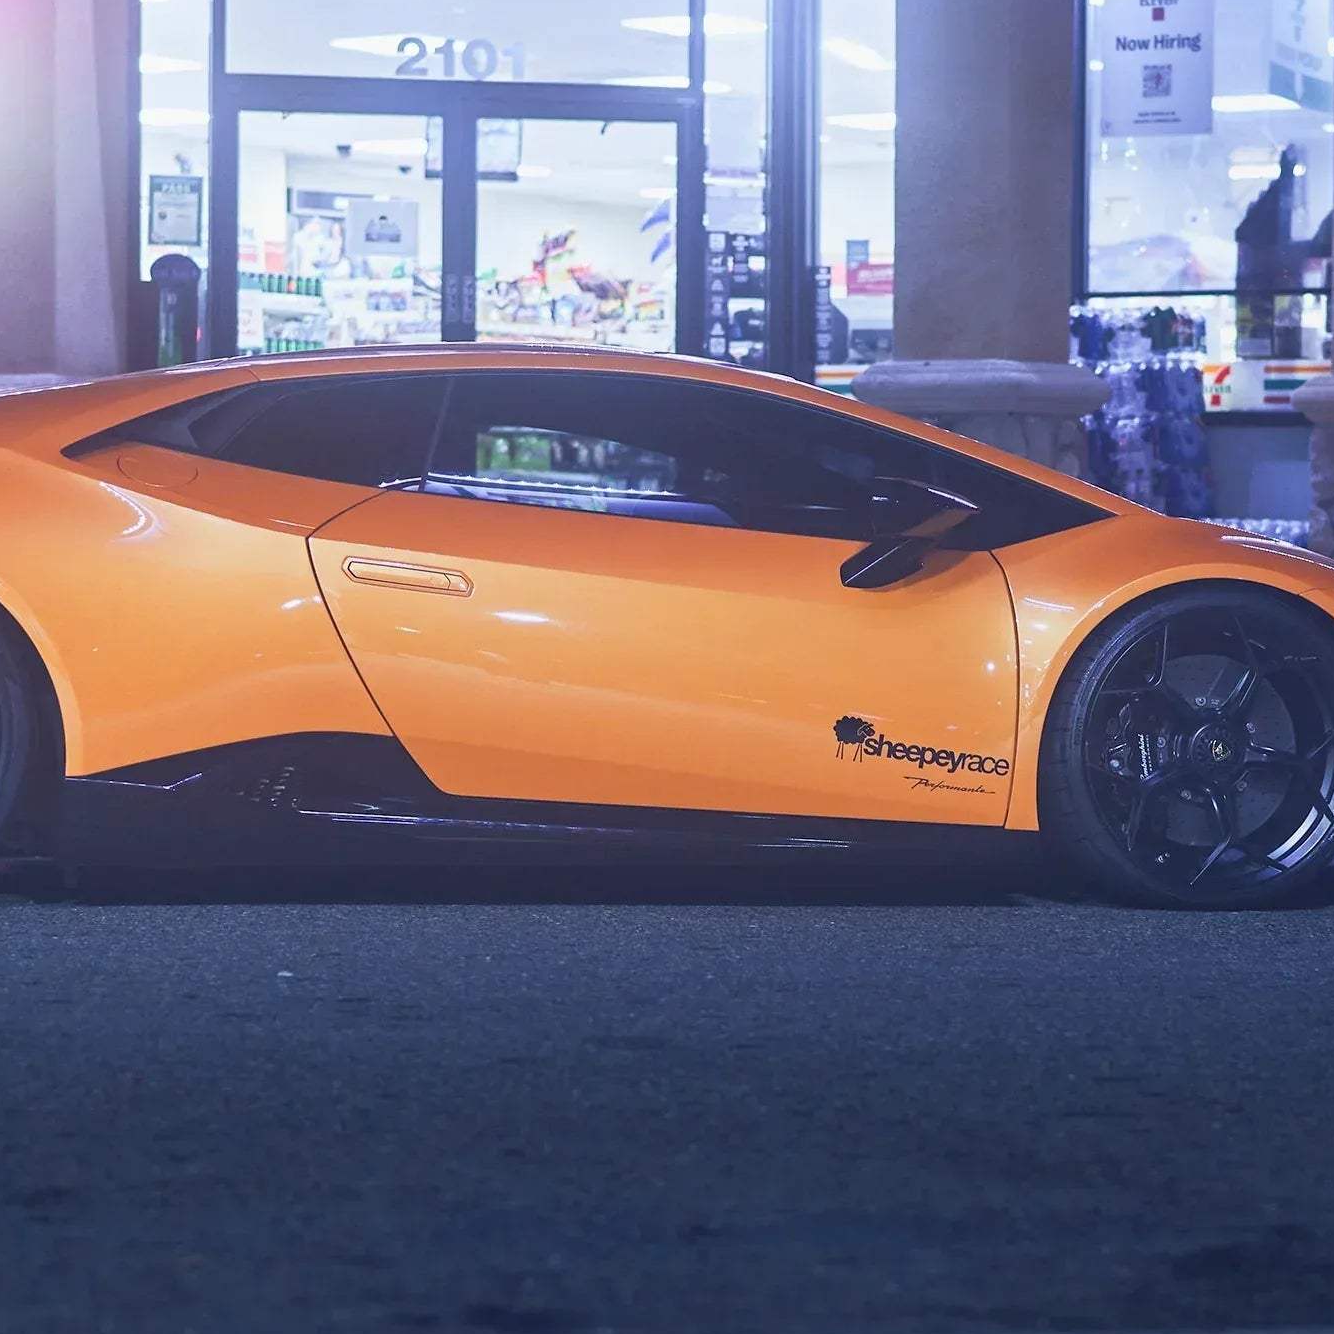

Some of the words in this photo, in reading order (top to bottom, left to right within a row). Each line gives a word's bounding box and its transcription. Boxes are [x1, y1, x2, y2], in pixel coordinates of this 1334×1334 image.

[395, 37, 525, 80] 2101
[1116, 37, 1150, 52] Now
[1154, 33, 1202, 53] Hiring
[863, 734, 1010, 776] sheepeyrace
[903, 775, 996, 794] Performante
